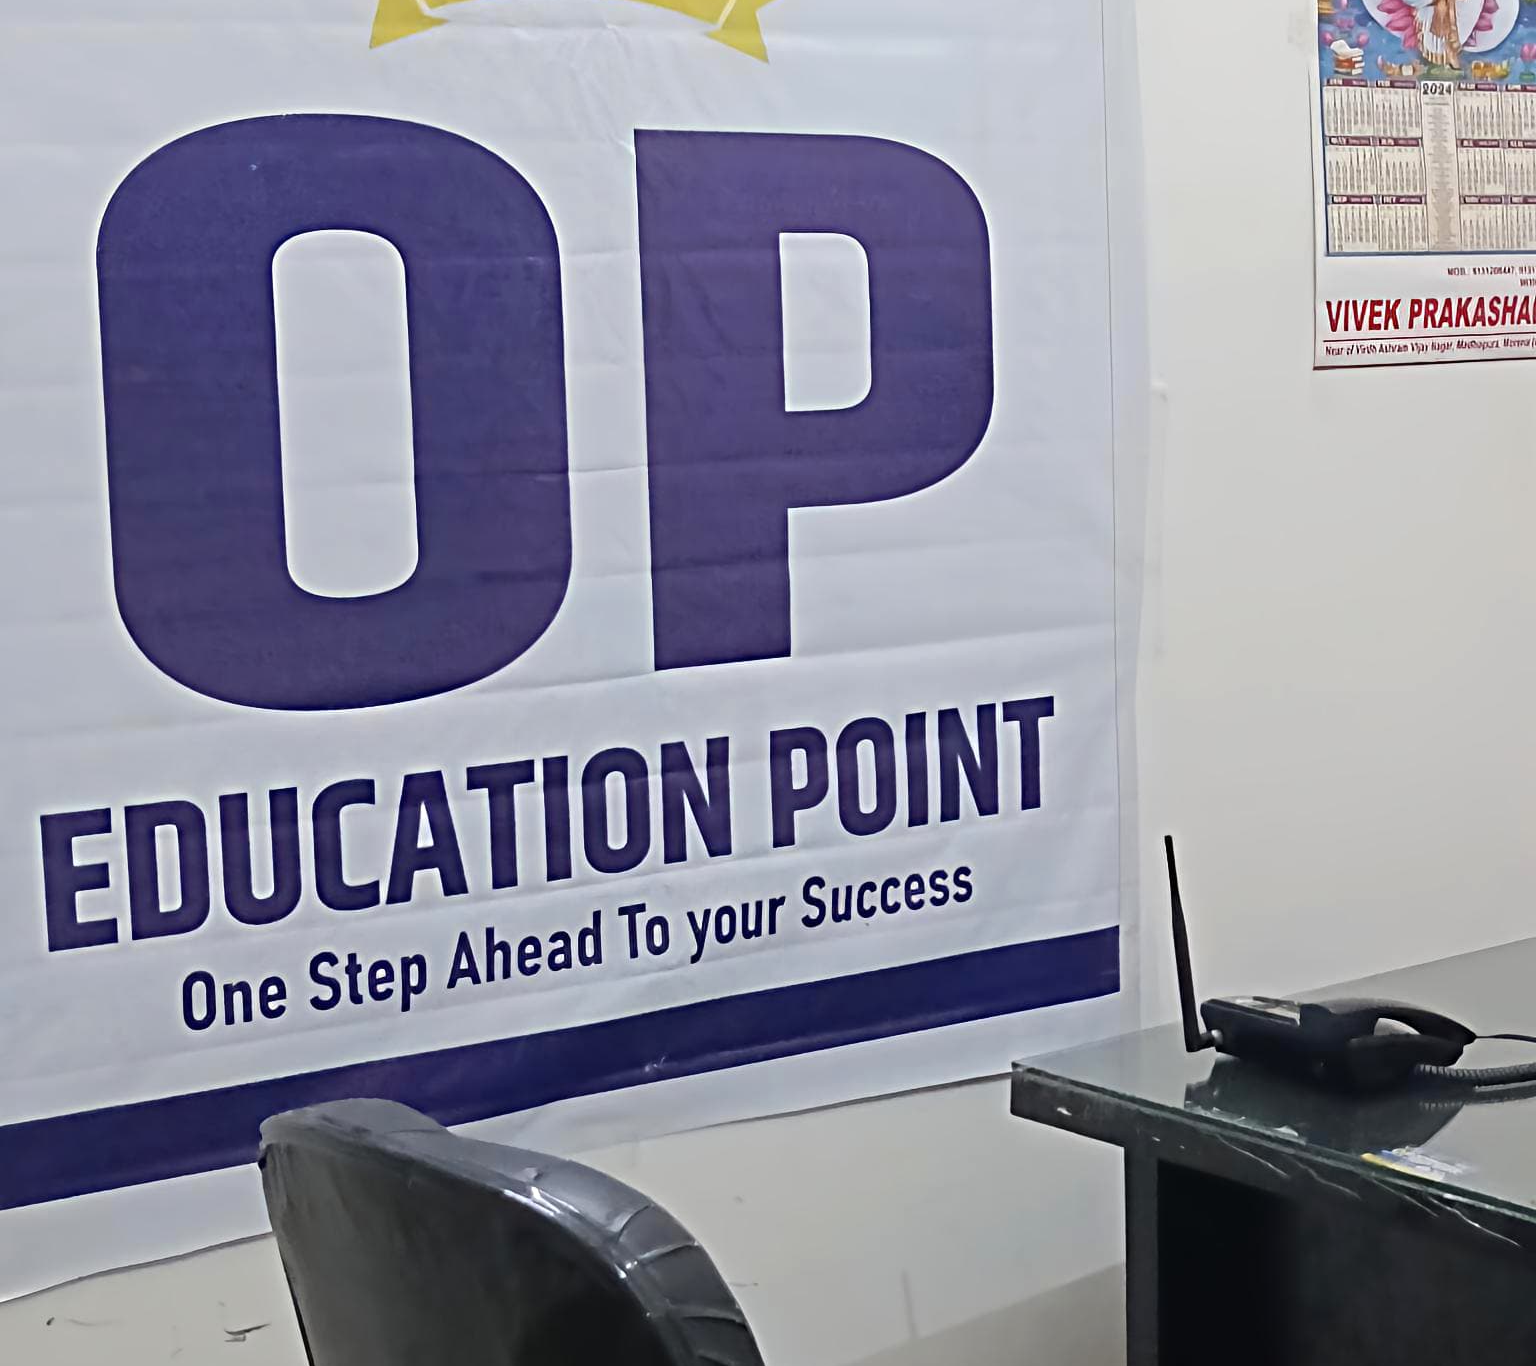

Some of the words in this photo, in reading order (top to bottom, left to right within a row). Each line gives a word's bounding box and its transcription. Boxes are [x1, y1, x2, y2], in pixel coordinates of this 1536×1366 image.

[1422, 82, 1451, 95] 2024
[1326, 298, 1402, 333] VIVEK
[97, 113, 995, 711] OP
[40, 737, 731, 952] EDUCATION
[770, 697, 1055, 848] POINT
[183, 971, 288, 1031] One
[309, 943, 428, 1013] Step
[447, 911, 602, 991] Ahead
[618, 902, 672, 960] To
[688, 895, 786, 965] your
[801, 865, 975, 929] Success
